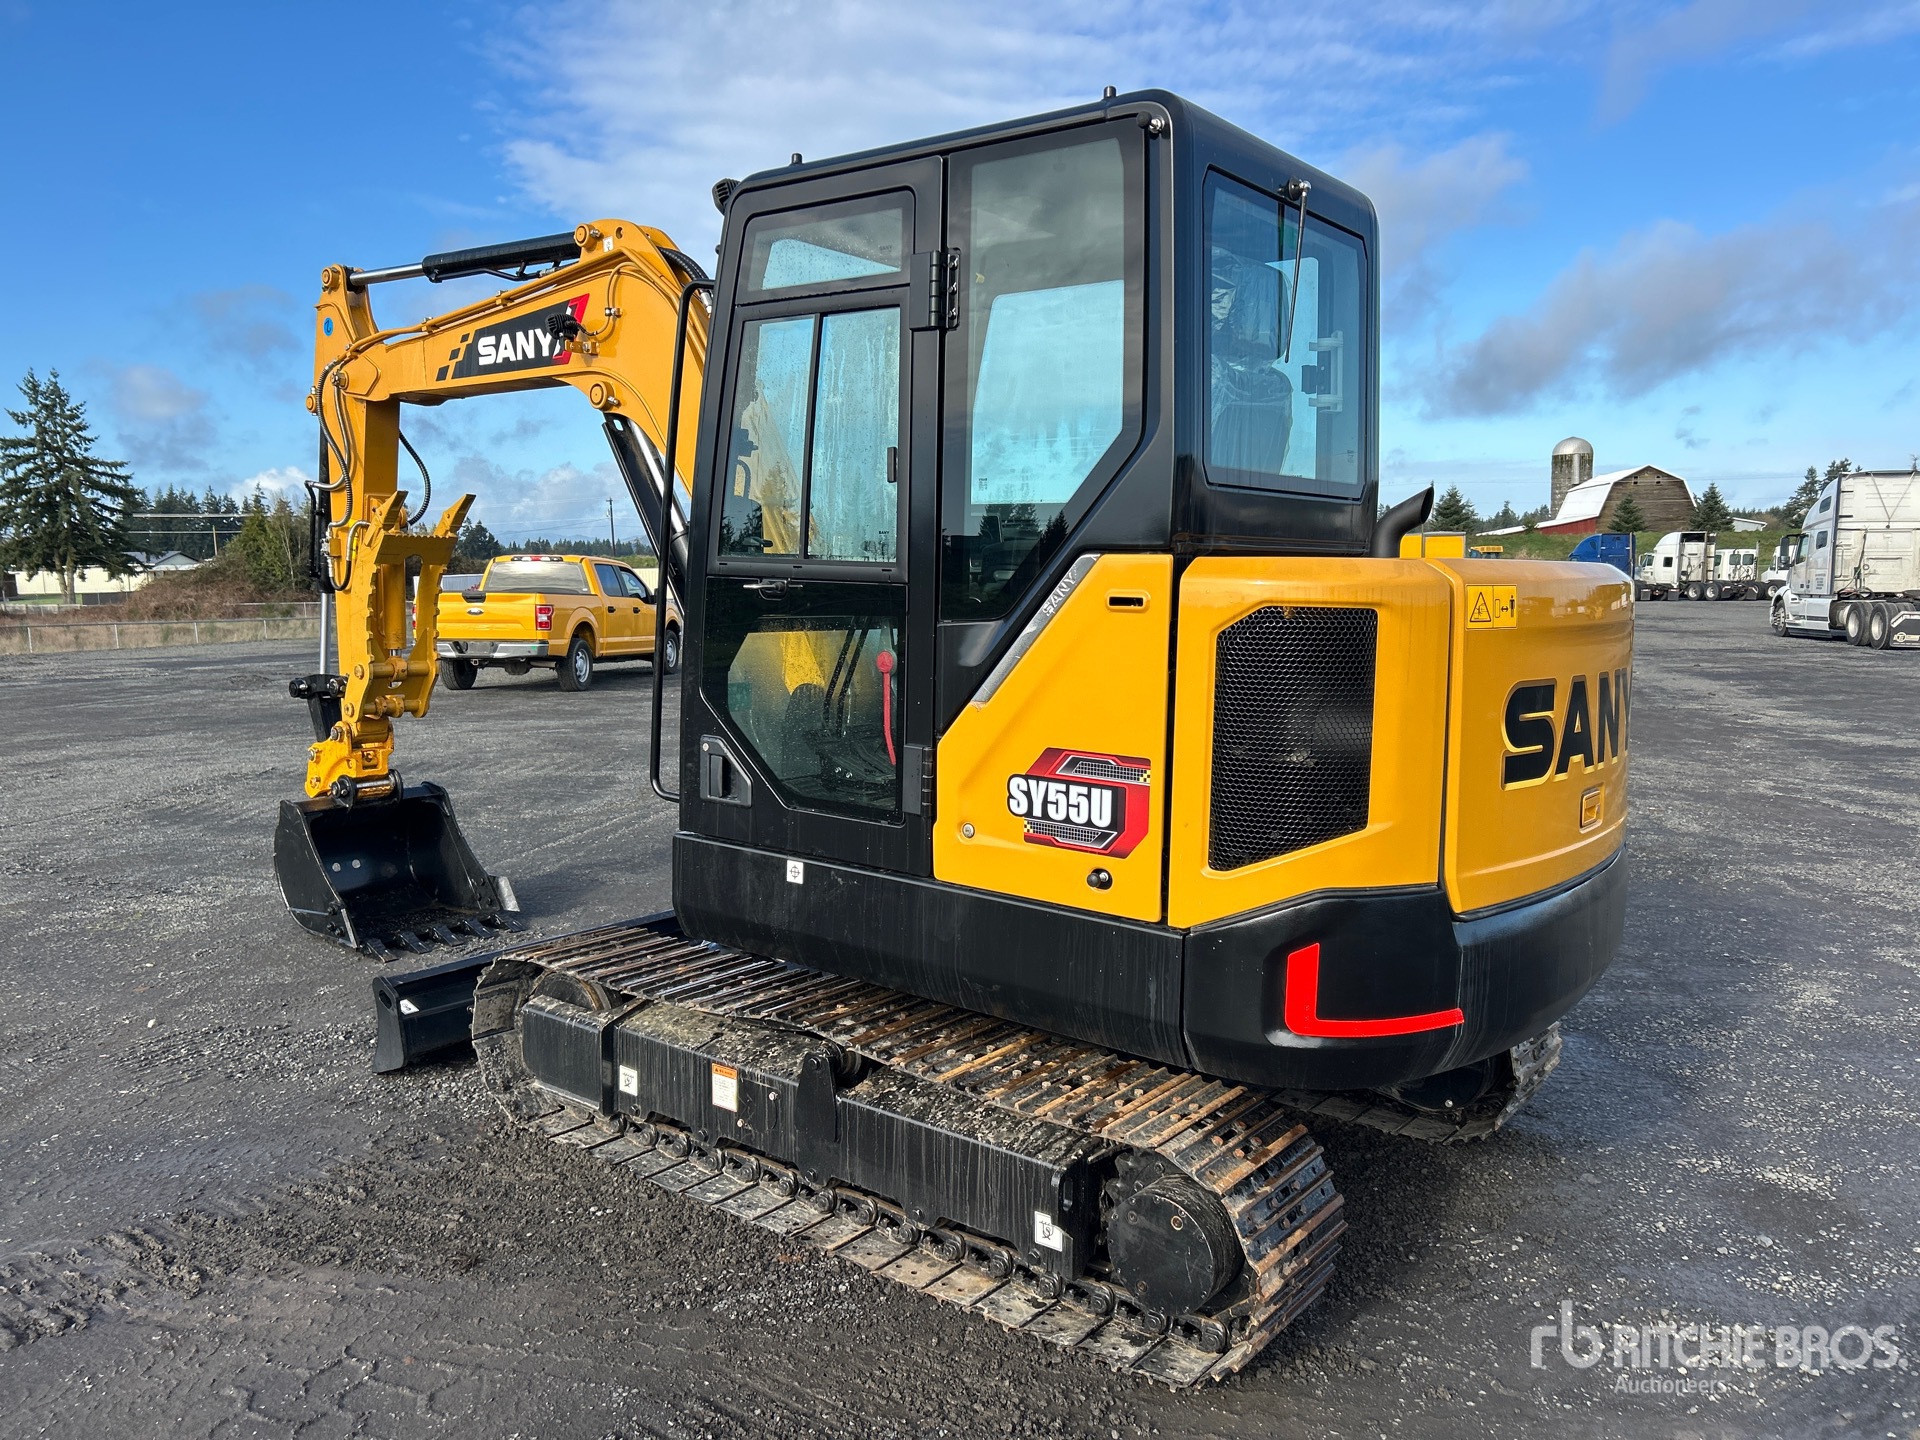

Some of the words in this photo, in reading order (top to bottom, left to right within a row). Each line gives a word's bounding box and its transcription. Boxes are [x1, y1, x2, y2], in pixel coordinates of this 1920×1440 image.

[477, 327, 553, 366] SANY
[1041, 571, 1077, 617] SANY
[1008, 776, 1113, 829] SY55U
